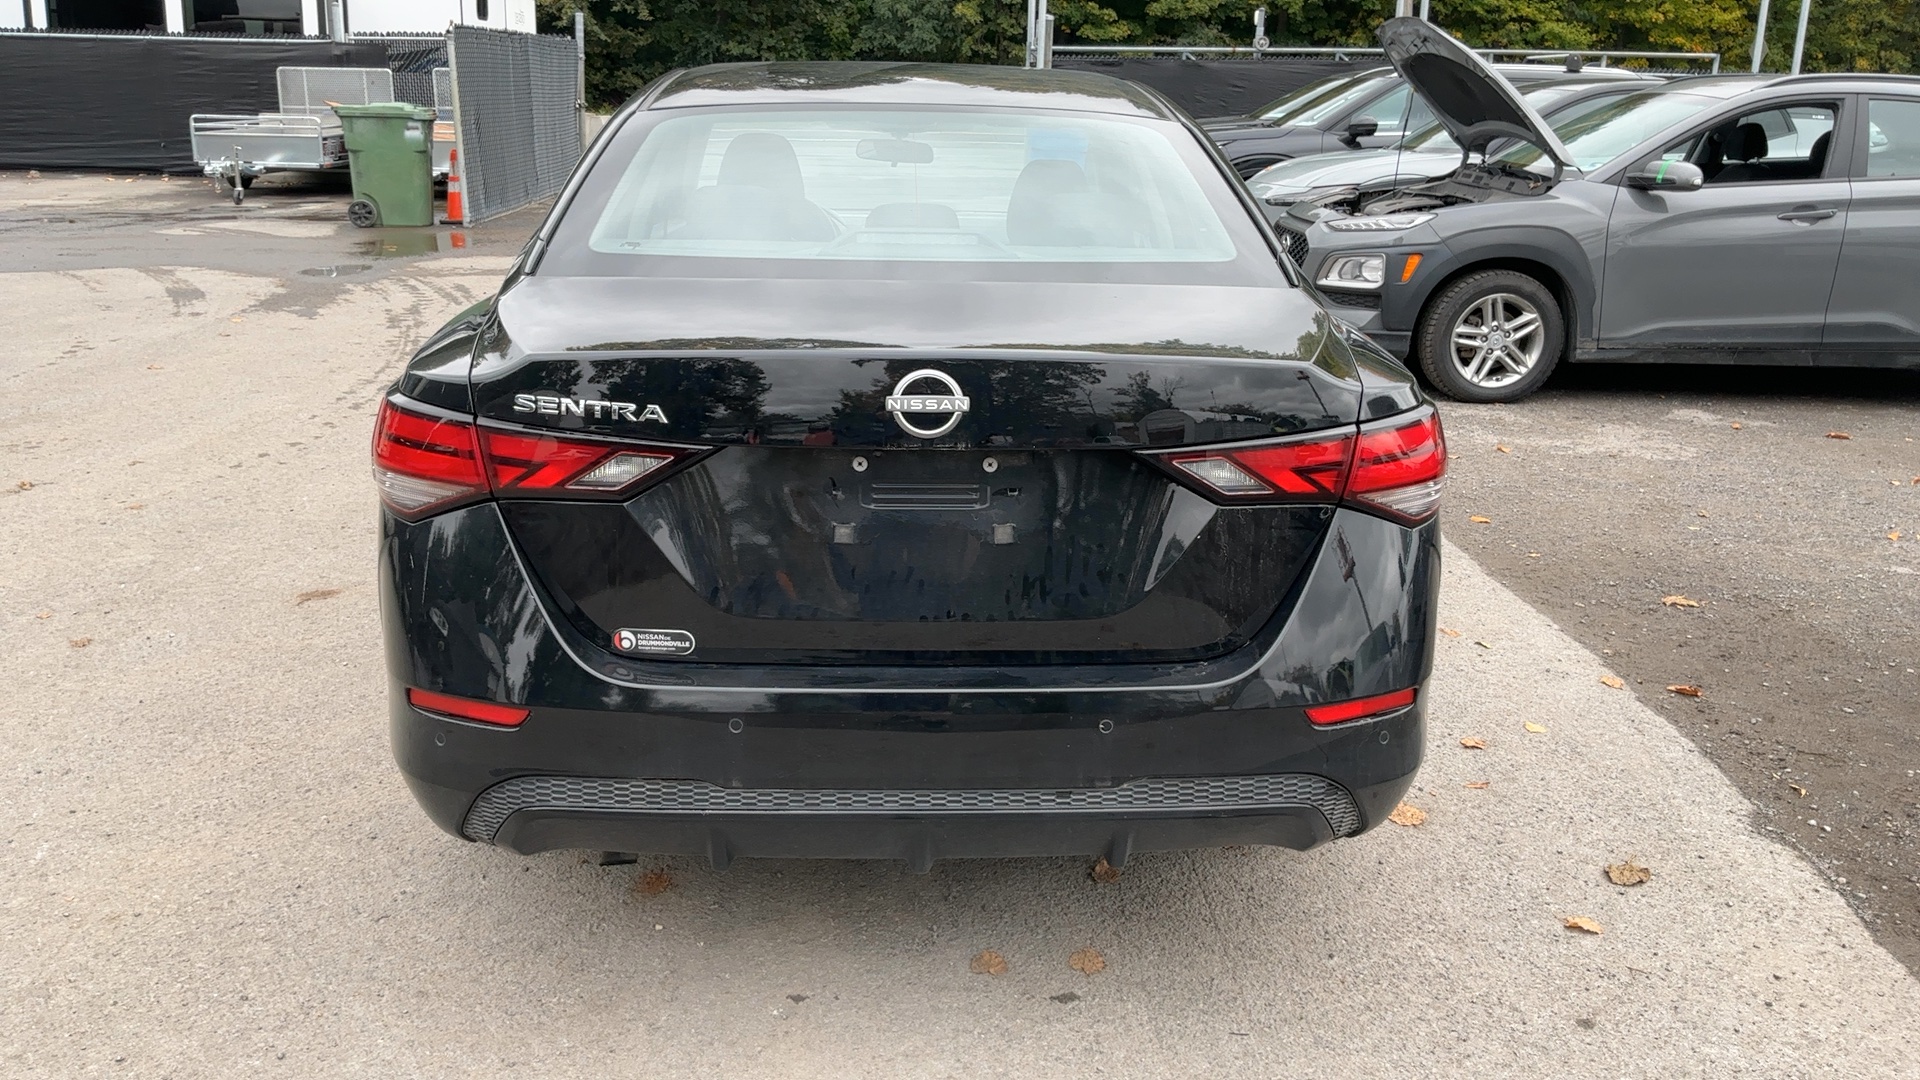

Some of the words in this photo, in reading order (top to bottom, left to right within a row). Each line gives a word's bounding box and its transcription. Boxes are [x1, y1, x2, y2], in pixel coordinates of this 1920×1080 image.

[513, 394, 669, 424] SENTRA
[888, 399, 968, 410] NISSAN
[637, 640, 690, 648] DRUMMONDVILLE
